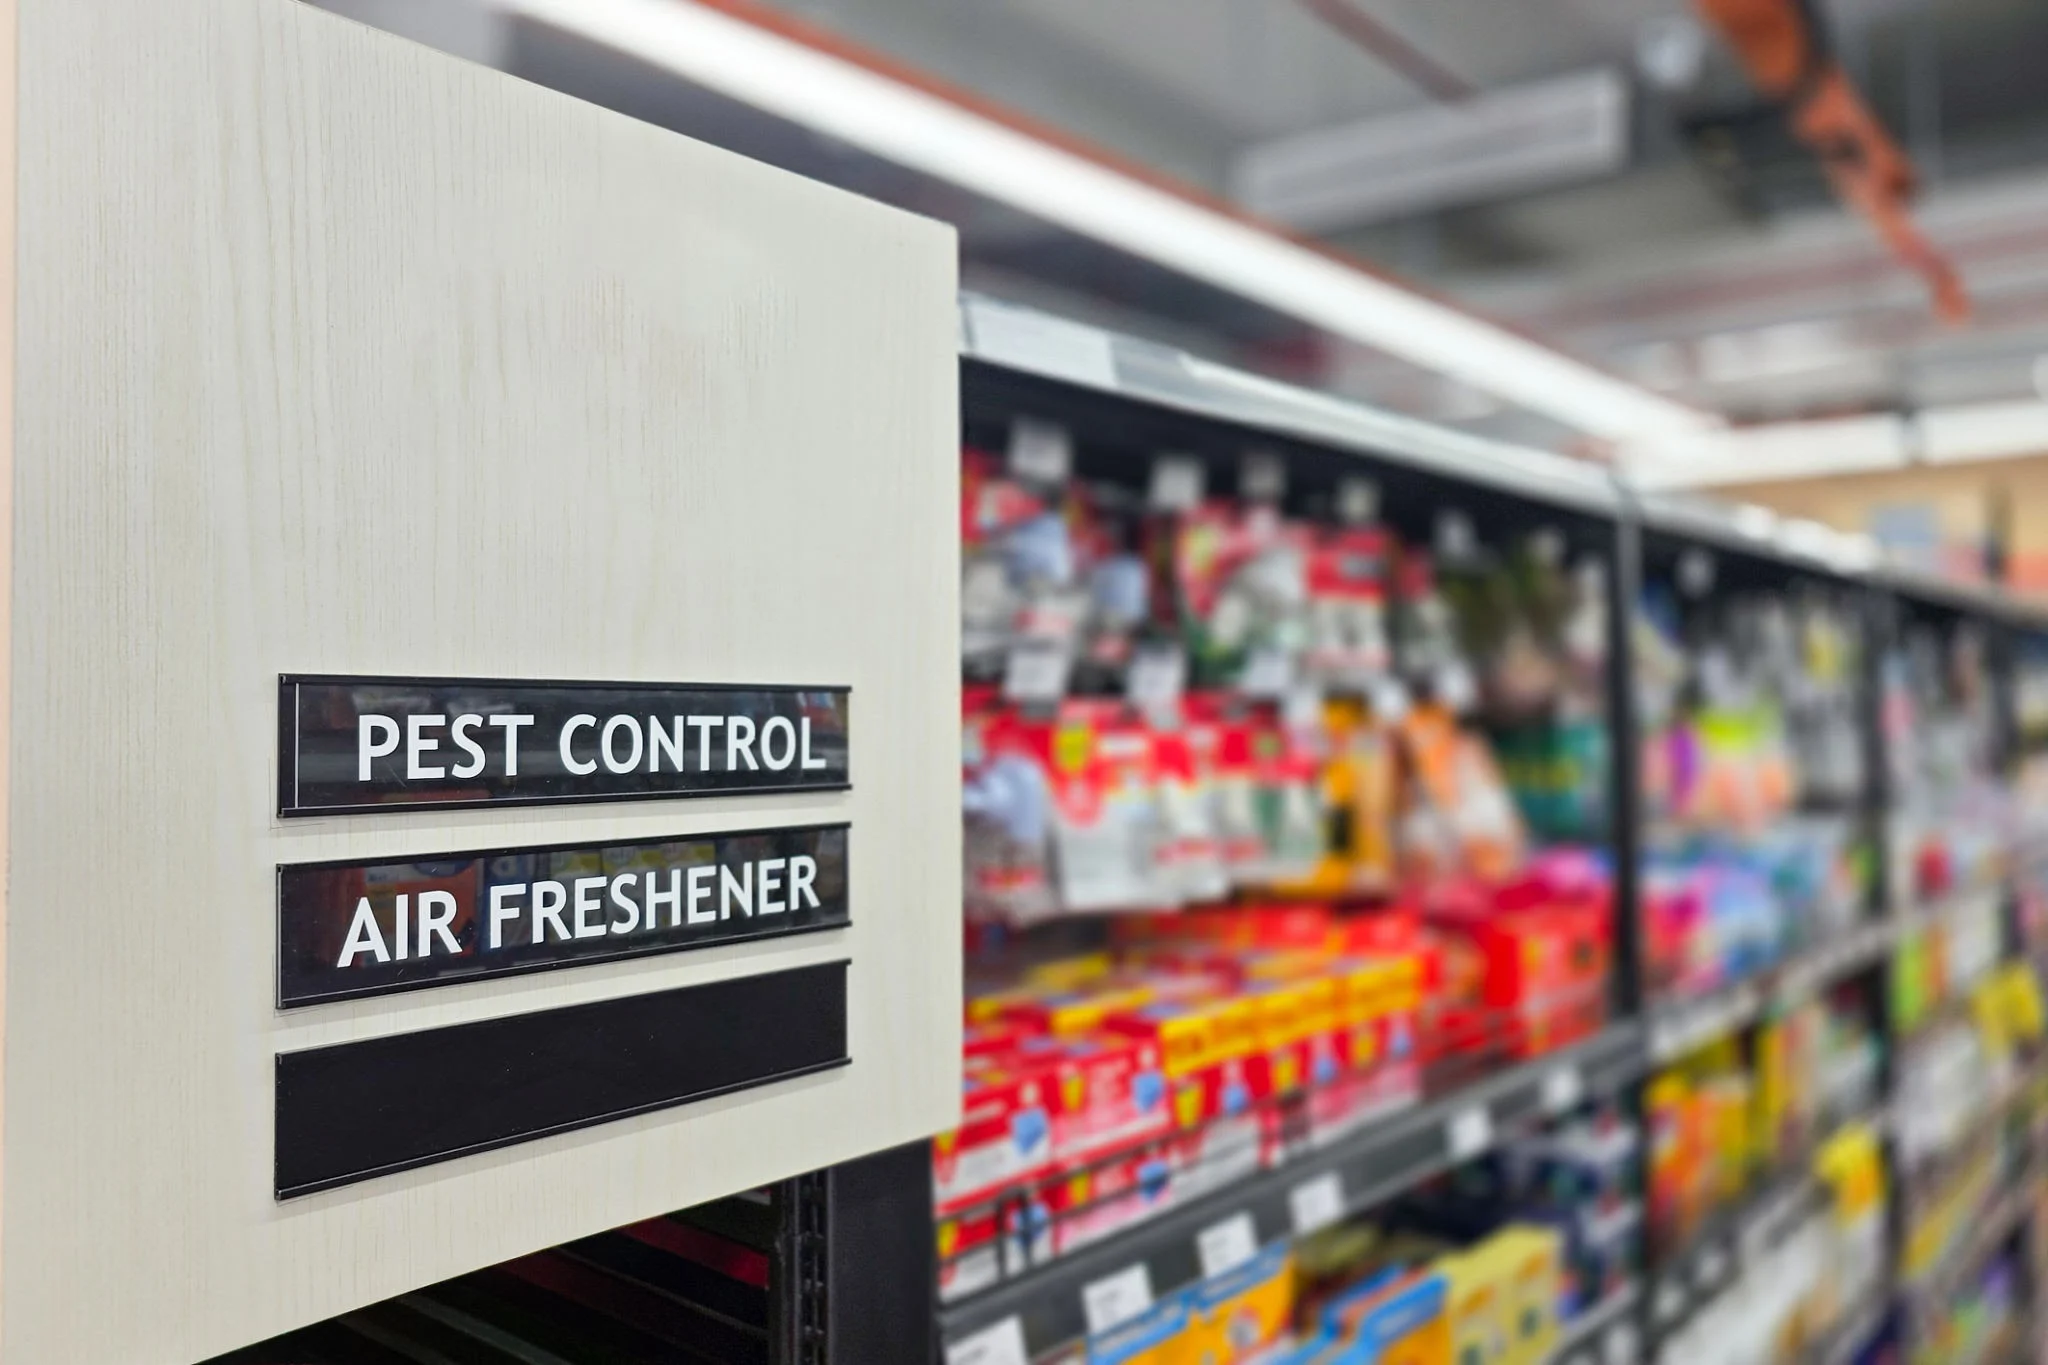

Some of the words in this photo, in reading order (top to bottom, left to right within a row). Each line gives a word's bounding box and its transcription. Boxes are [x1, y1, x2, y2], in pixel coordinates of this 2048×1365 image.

[358, 713, 535, 782] PEST
[559, 713, 827, 775] CONTROL
[336, 890, 463, 968] AIR
[490, 855, 821, 949] FRESHENER
